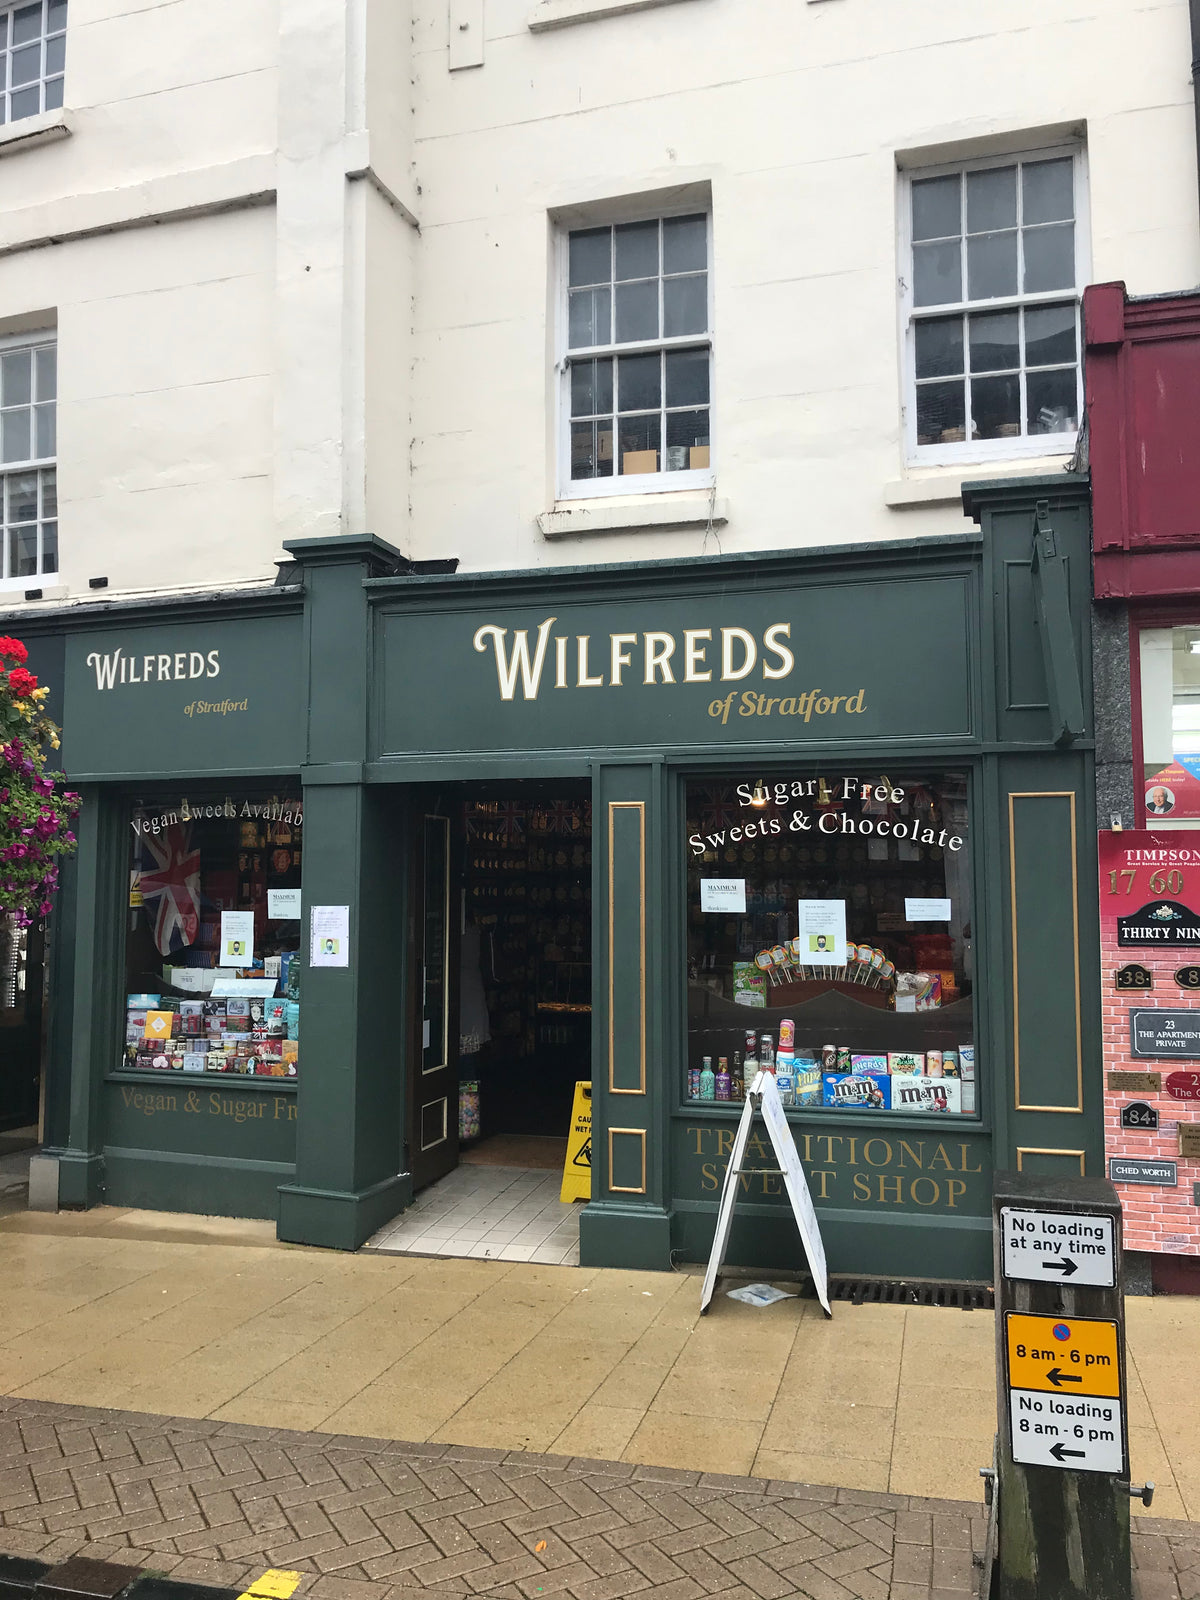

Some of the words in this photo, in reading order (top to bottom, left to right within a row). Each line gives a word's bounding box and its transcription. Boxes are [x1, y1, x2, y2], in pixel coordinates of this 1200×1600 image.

[184, 701, 197, 718] of
[197, 698, 248, 716] Stratford
[708, 691, 736, 725] of
[738, 688, 866, 723] Stratford
[736, 779, 816, 807] Sugar
[841, 777, 905, 803] Free
[130, 812, 177, 836] Vegan
[182, 803, 236, 821] Sweets
[689, 818, 780, 855] Sweets
[789, 810, 811, 831] &
[818, 812, 963, 851] Chocolate
[1122, 927, 1170, 939] THIRTY
[1123, 971, 1145, 985] 38
[1165, 1020, 1175, 1029] 23
[1173, 1088, 1192, 1097] The
[120, 1087, 177, 1115] Vegan
[183, 1091, 201, 1113] &
[209, 1093, 267, 1122] Sugar
[1129, 1110, 1151, 1125] 84
[687, 1127, 982, 1173] TRAITIONAL
[1115, 1166, 1139, 1175] CHED
[1141, 1168, 1171, 1177] WORTH
[853, 1172, 967, 1208] SHOP
[1012, 1218, 1035, 1232] No
[1042, 1220, 1104, 1240] loading
[1010, 1236, 1027, 1249] at
[1033, 1239, 1062, 1254] any
[1068, 1240, 1106, 1255] time
[1016, 1344, 1027, 1358] 8
[1031, 1348, 1055, 1361] am
[1070, 1350, 1081, 1363] 6
[1085, 1353, 1111, 1366] pm
[1019, 1396, 1043, 1412] No
[1049, 1399, 1112, 1421] loading
[1019, 1419, 1030, 1432] 8
[1034, 1423, 1058, 1436] am
[1073, 1425, 1084, 1438] 6
[1088, 1428, 1114, 1442] pm
